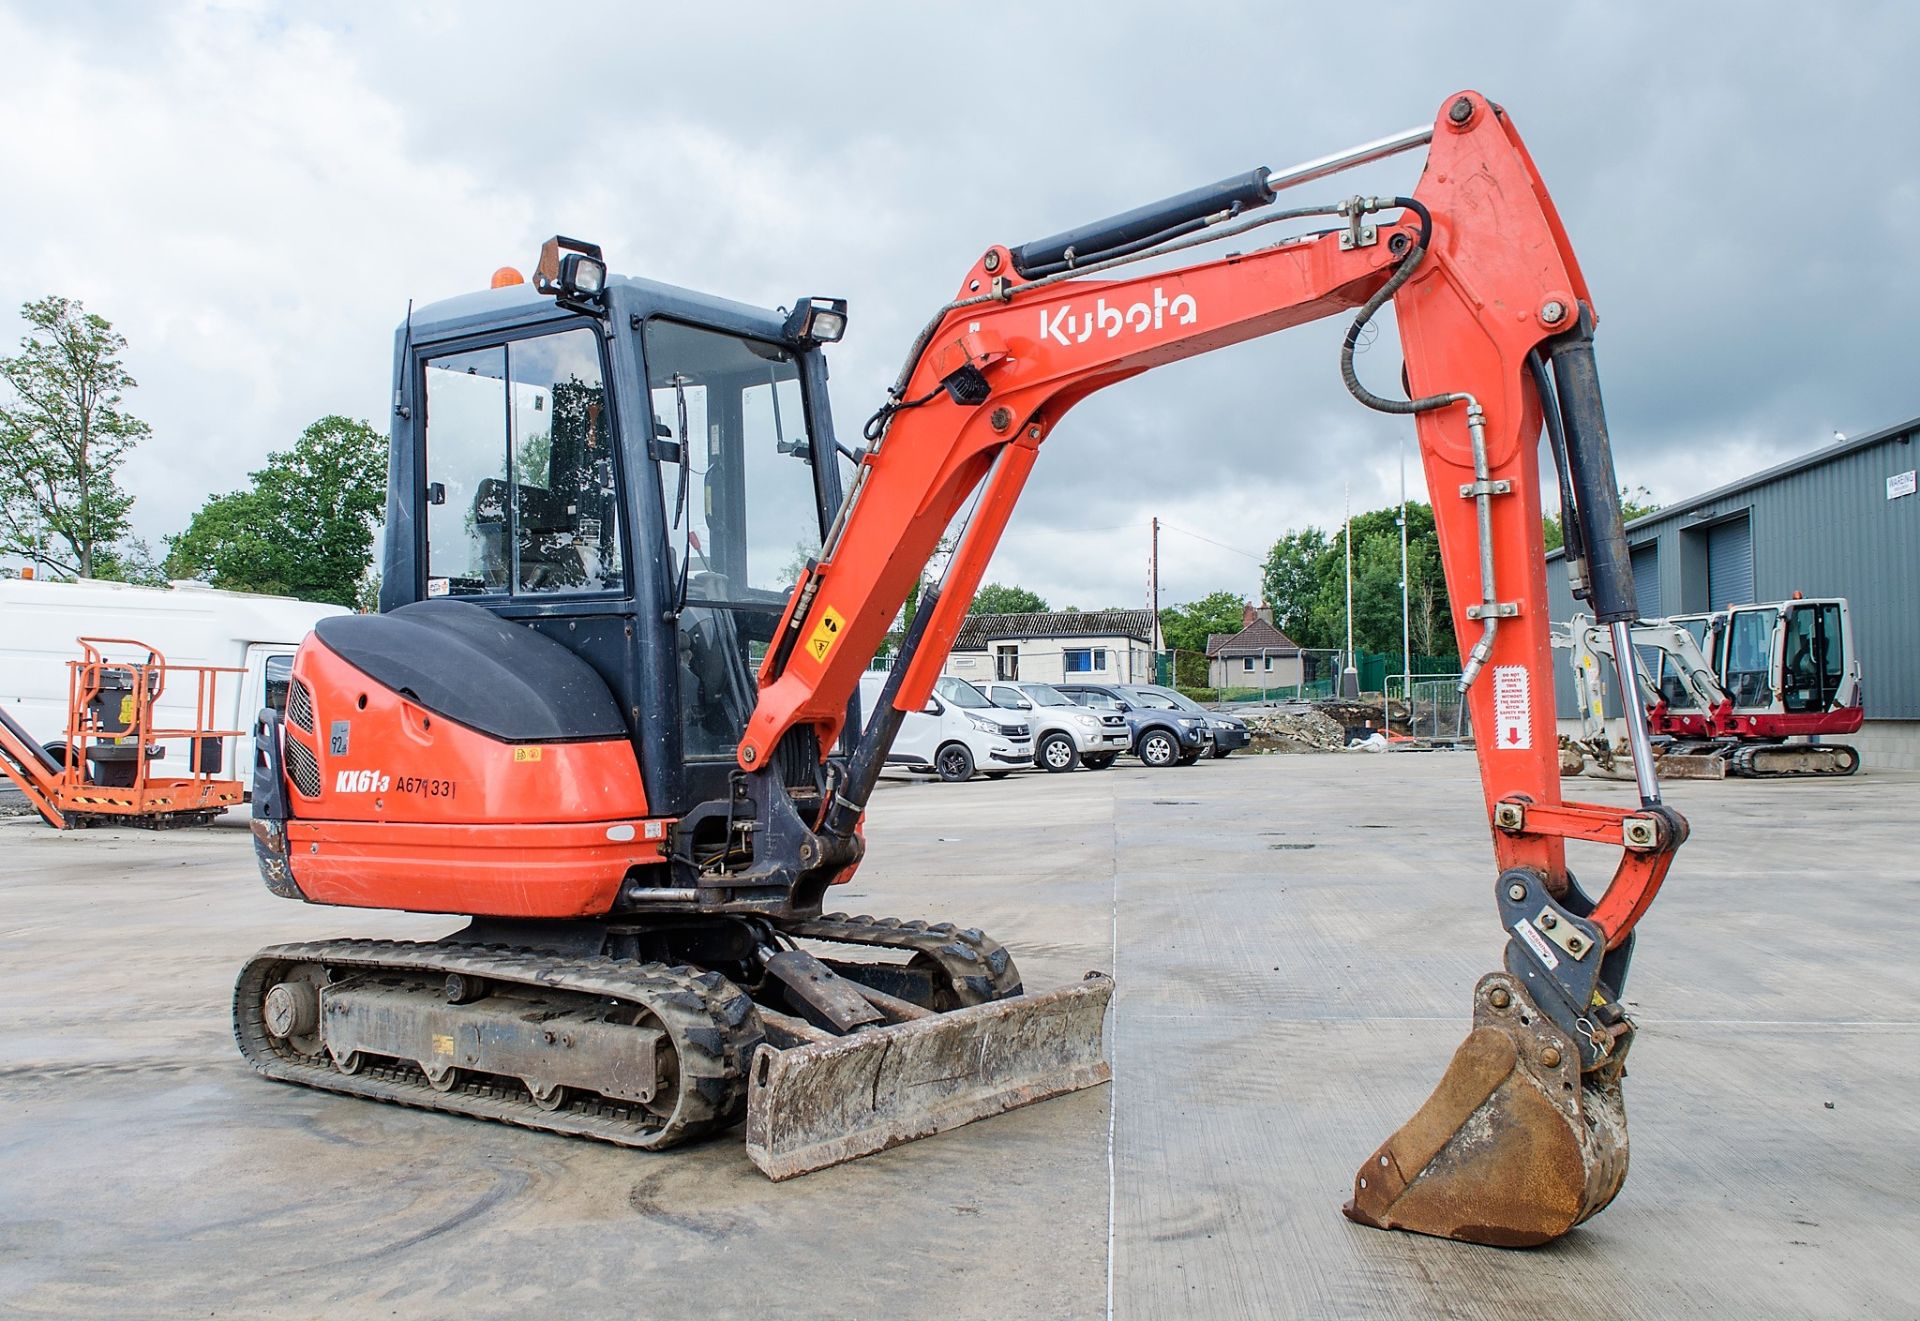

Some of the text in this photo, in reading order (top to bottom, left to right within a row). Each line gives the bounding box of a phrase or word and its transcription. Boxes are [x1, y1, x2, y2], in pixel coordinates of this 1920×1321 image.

[1040, 287, 1197, 346] Kubota
[331, 736, 342, 753] 92
[335, 770, 390, 793] KX61-3
